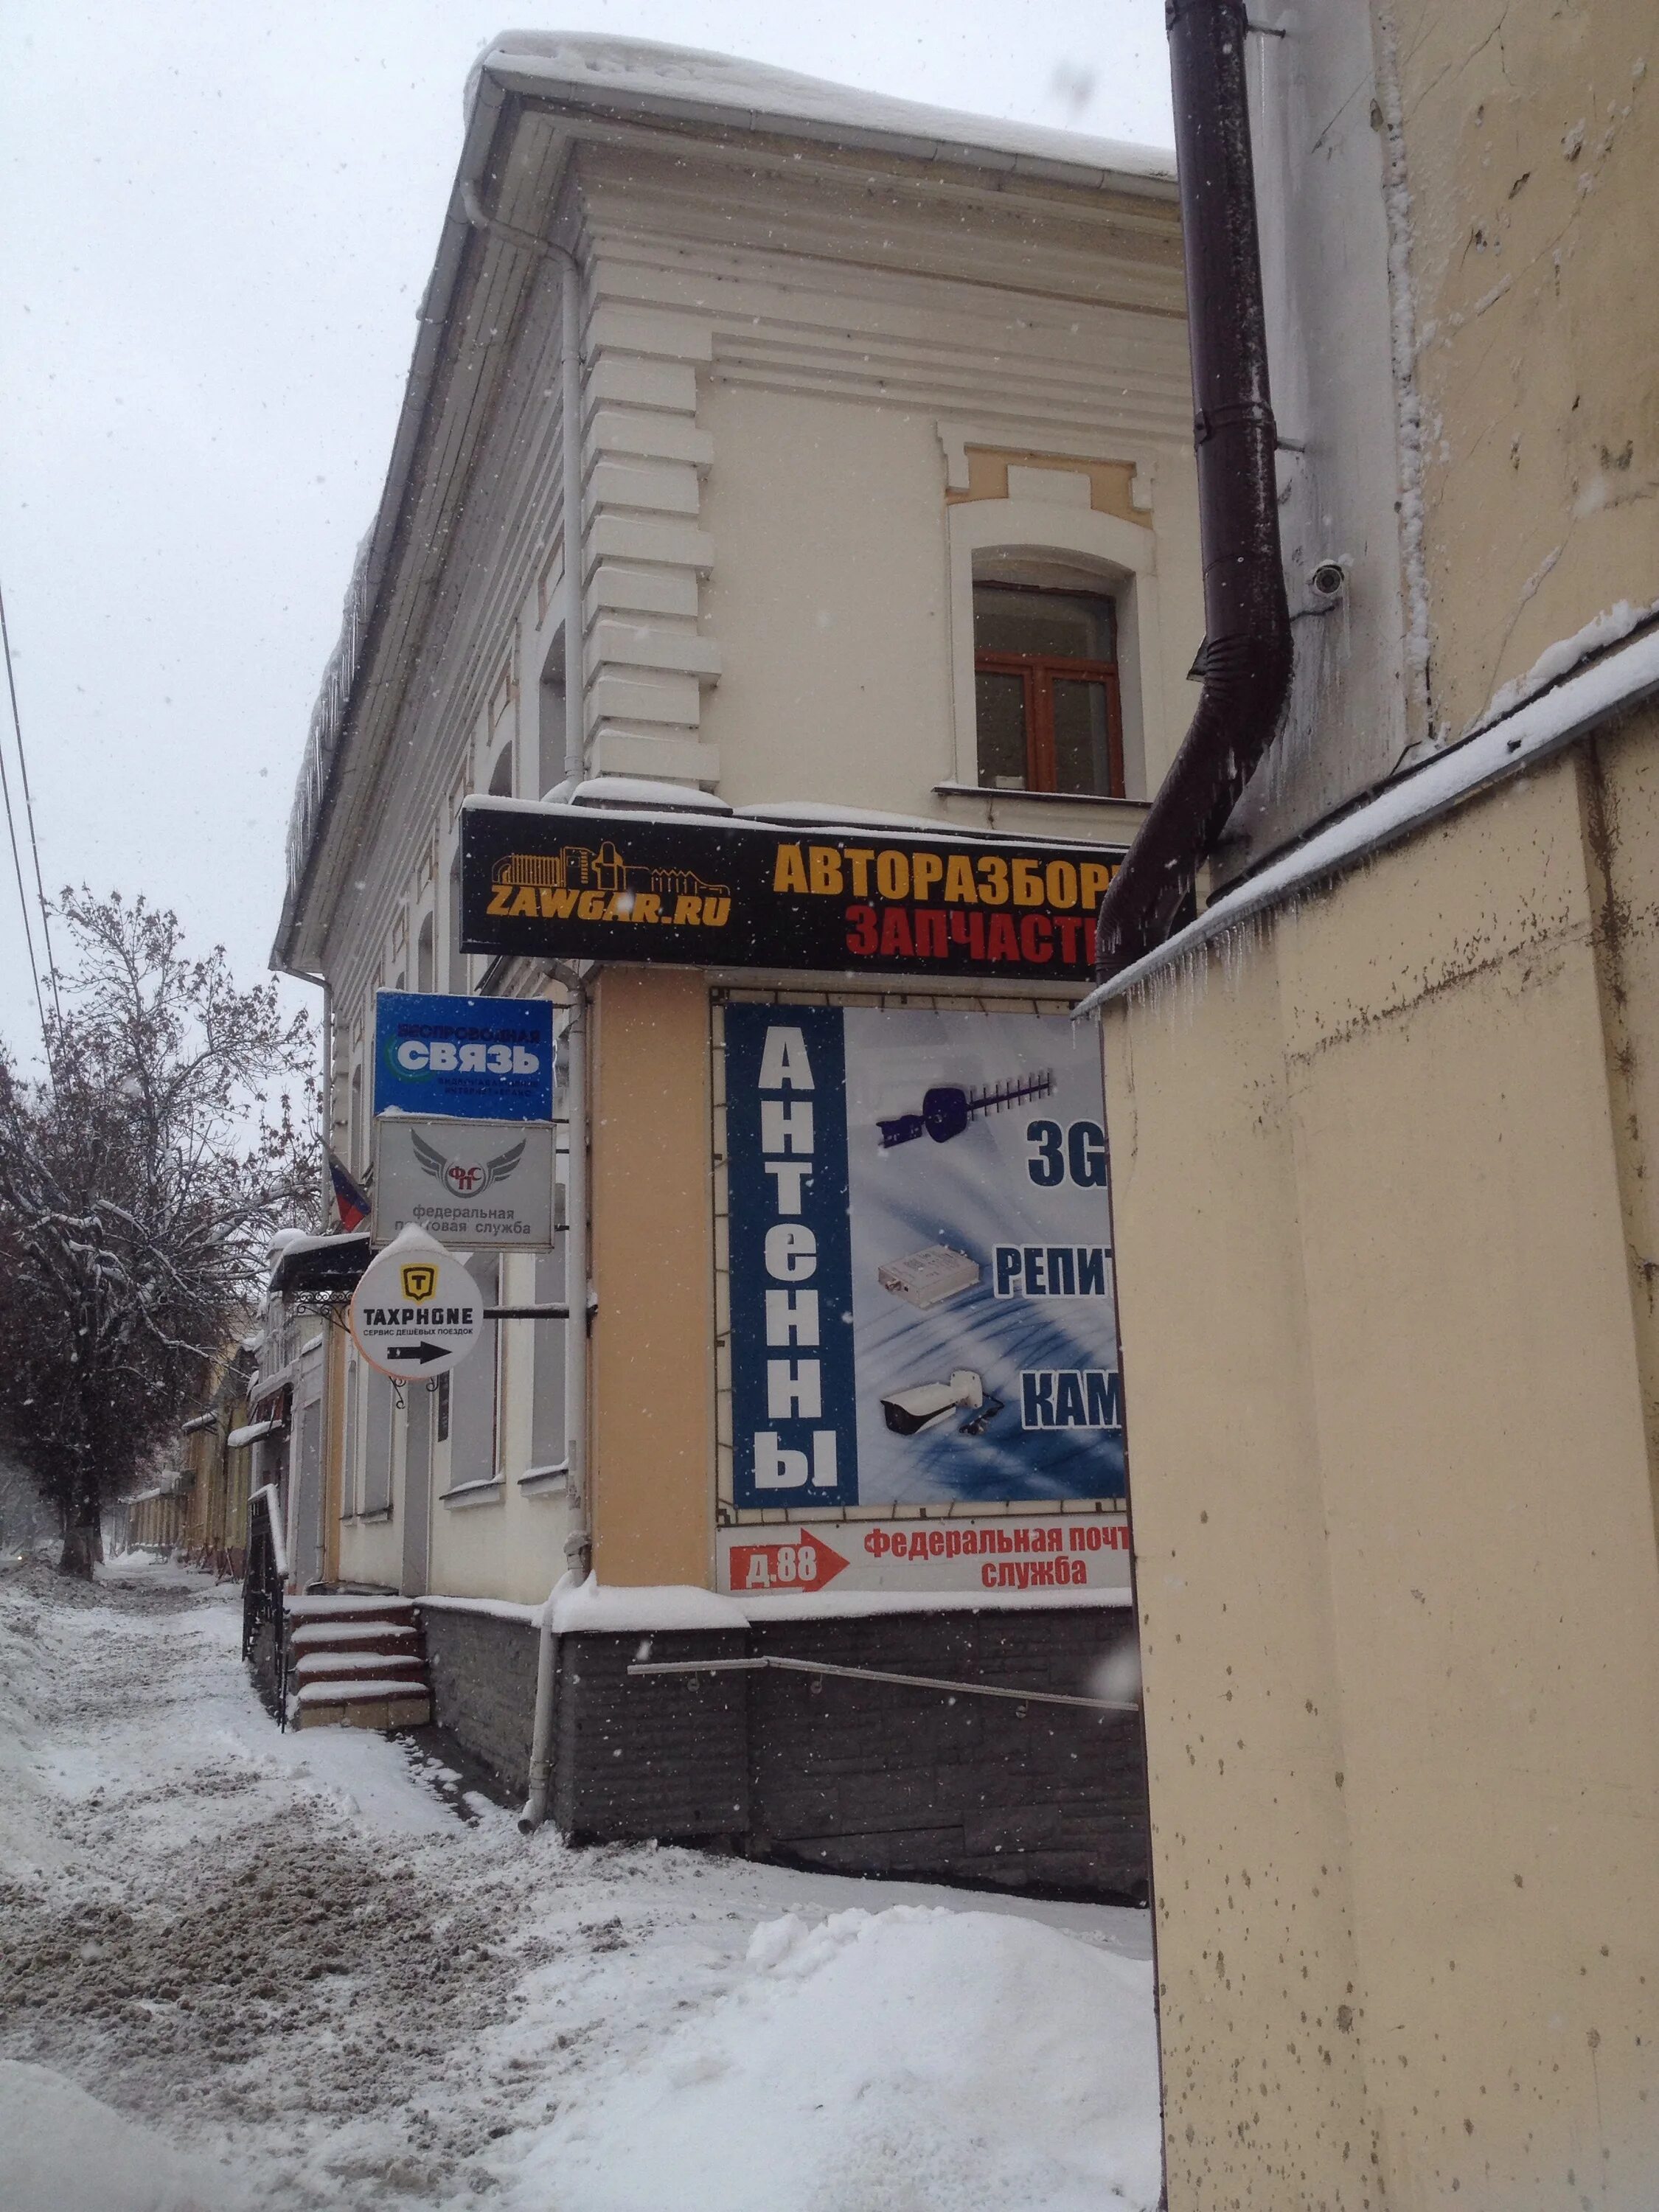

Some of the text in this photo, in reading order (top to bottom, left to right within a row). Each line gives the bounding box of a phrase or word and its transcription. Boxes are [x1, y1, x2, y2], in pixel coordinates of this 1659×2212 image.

[773, 843, 1121, 909] АВТОРАЗБОР
[486, 884, 732, 927] ZAWGAR.RU
[394, 1220, 531, 1237] птовая служба
[412, 1204, 515, 1220] федеральная
[364, 1307, 473, 1326] TAXPHONE
[863, 1528, 1062, 1561] Федеральная
[981, 1555, 1088, 1590] служба
